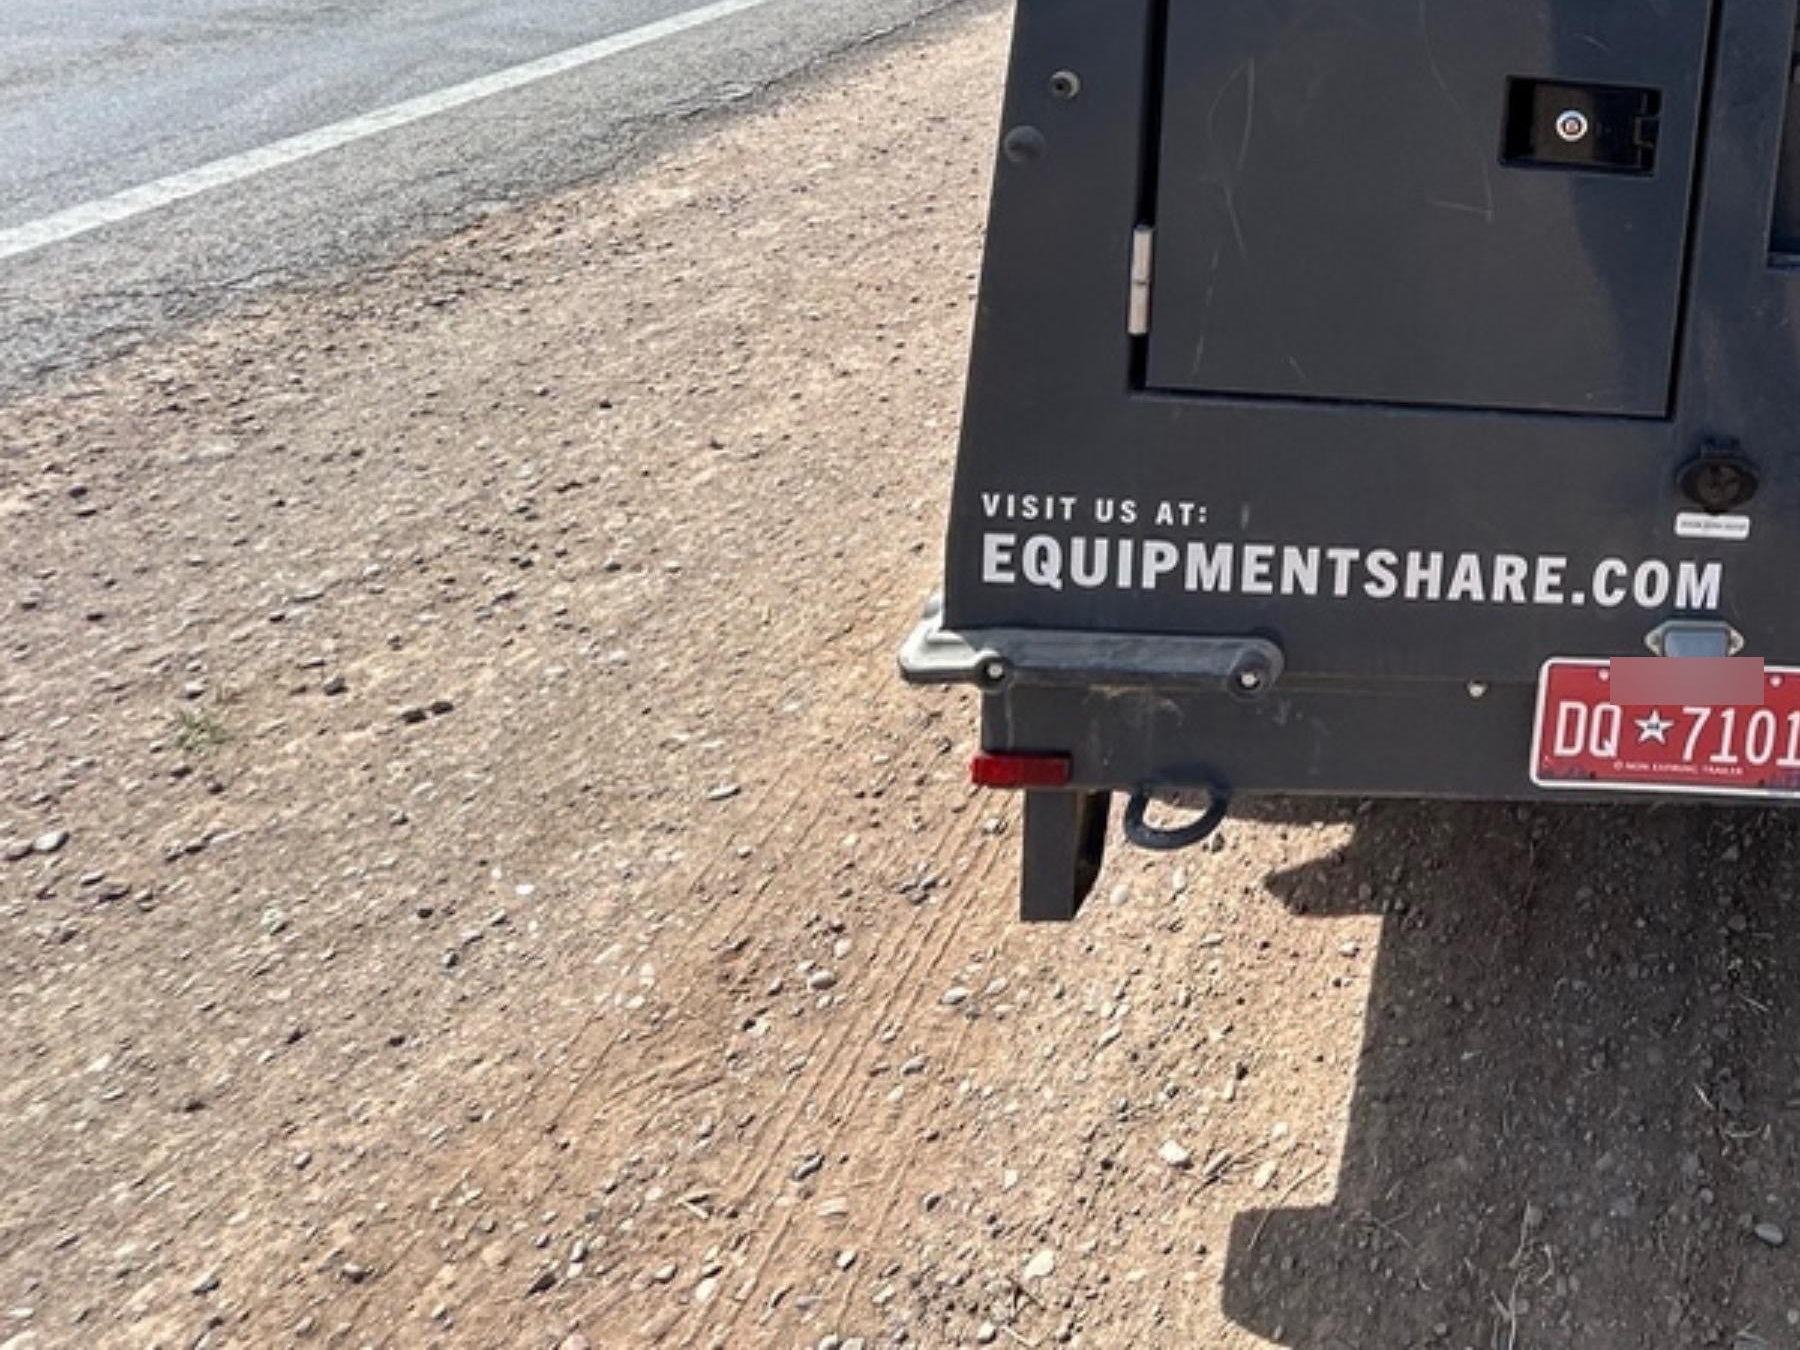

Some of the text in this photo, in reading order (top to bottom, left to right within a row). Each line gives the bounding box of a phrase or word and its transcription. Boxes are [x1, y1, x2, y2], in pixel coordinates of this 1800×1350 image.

[981, 493, 1208, 527] VISIT US AT:
[982, 532, 1723, 611] EQUIPMENTSHARE.COM
[1553, 699, 1622, 758] DQ
[1652, 762, 1699, 775] EXPIRING
[1702, 764, 1744, 777] TRAILER
